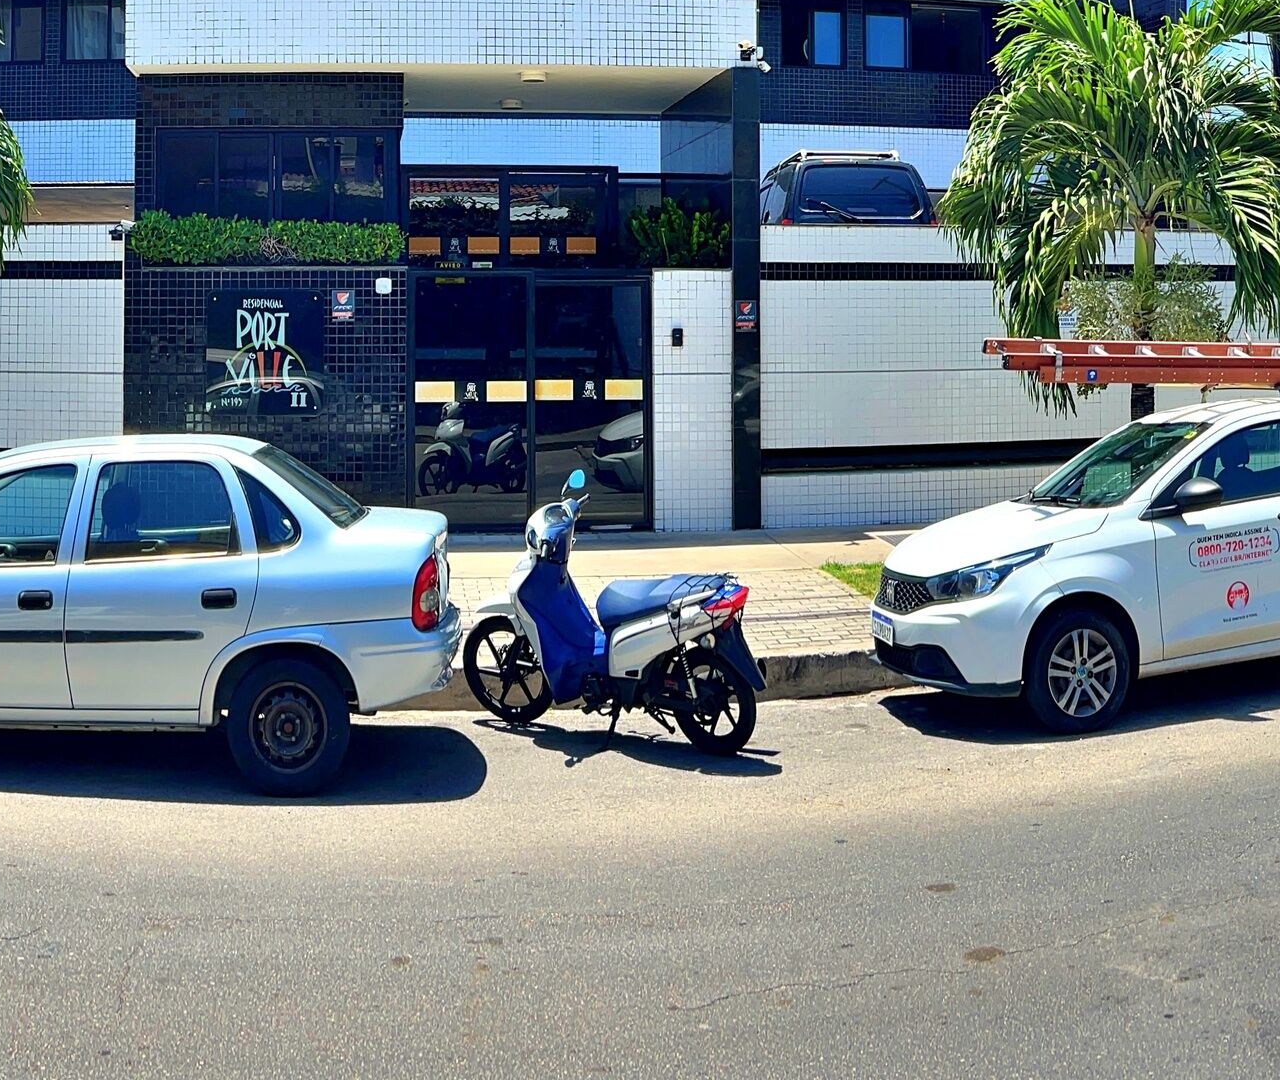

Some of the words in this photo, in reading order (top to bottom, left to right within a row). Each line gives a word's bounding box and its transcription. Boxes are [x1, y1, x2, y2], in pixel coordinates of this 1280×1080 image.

[243, 299, 283, 309] RESIDENCIAL
[236, 309, 289, 350] PORT
[290, 392, 307, 407] II
[1197, 535, 1212, 544] QUEM
[1244, 527, 1262, 536] ASSINE
[1197, 535, 1272, 557] 0800-720-1234
